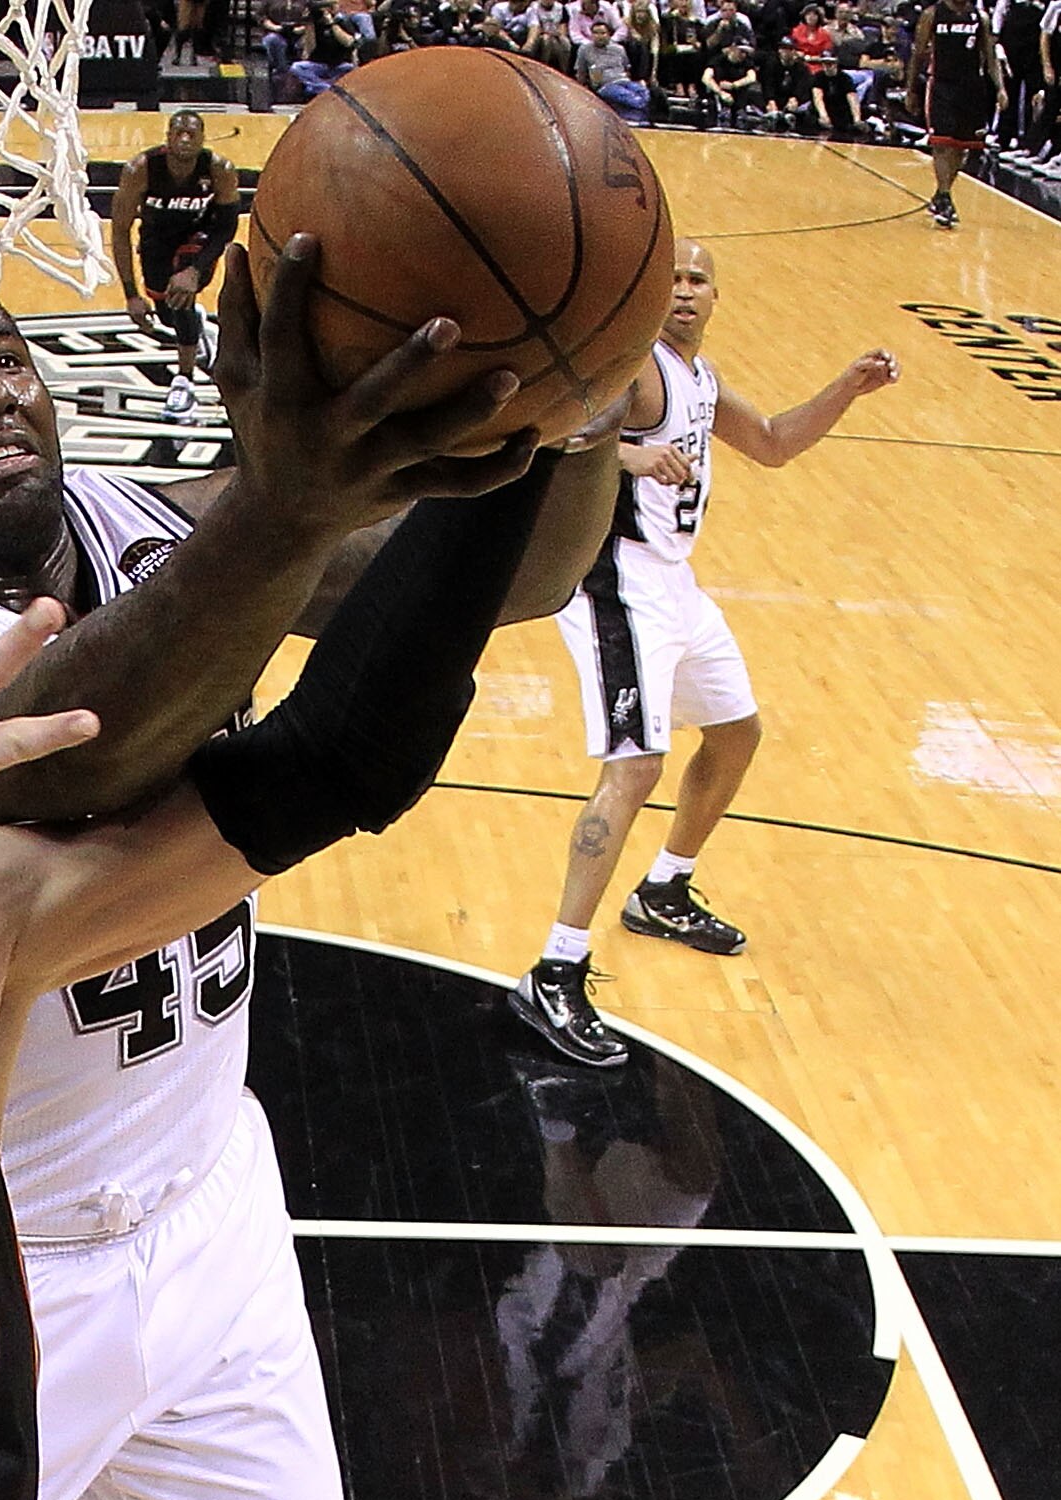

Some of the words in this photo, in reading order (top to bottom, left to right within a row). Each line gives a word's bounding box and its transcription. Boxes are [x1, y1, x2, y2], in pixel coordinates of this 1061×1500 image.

[80, 35, 112, 59] BA
[113, 35, 145, 59] TV
[146, 196, 164, 209] EL
[167, 193, 215, 210] HEAT
[61, 894, 257, 1070] 45
